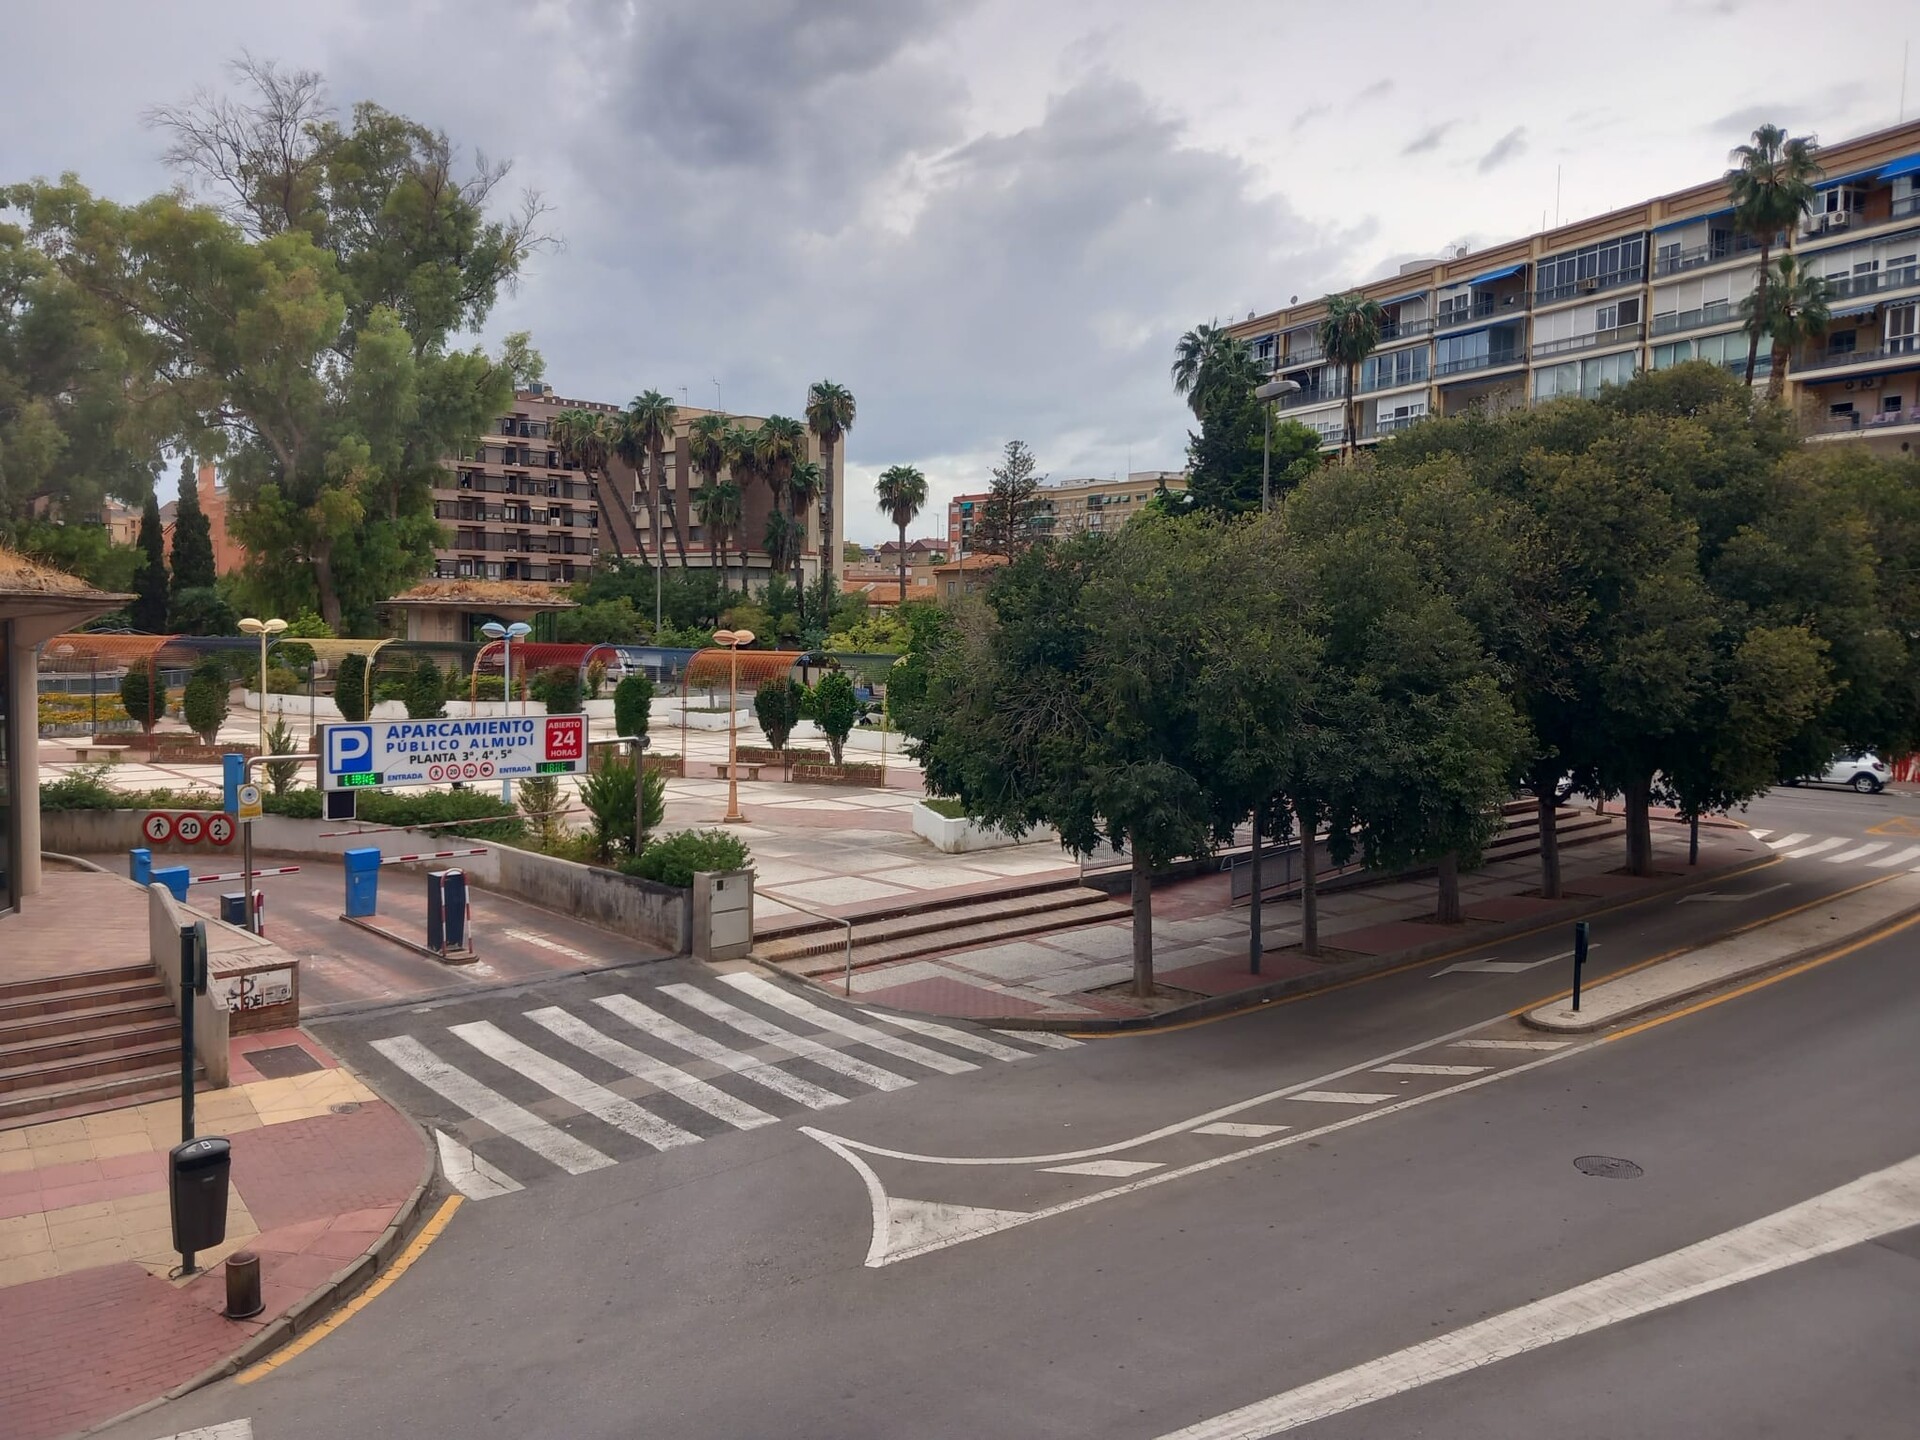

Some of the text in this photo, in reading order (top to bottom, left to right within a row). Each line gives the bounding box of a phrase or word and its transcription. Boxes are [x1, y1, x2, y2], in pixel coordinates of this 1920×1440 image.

[386, 720, 534, 739] APARCAMIENTO
[548, 721, 581, 729] ABIERTO
[386, 733, 534, 753] PÚBLICO ALMUDÍ
[552, 730, 576, 747] 24
[332, 730, 369, 771] P
[550, 748, 577, 757] HORAS
[409, 753, 456, 764] PLANTA
[499, 766, 532, 774] ENTRADA
[540, 761, 567, 773] LIBRE
[387, 773, 423, 781] ENTRADA
[181, 823, 198, 834] 20
